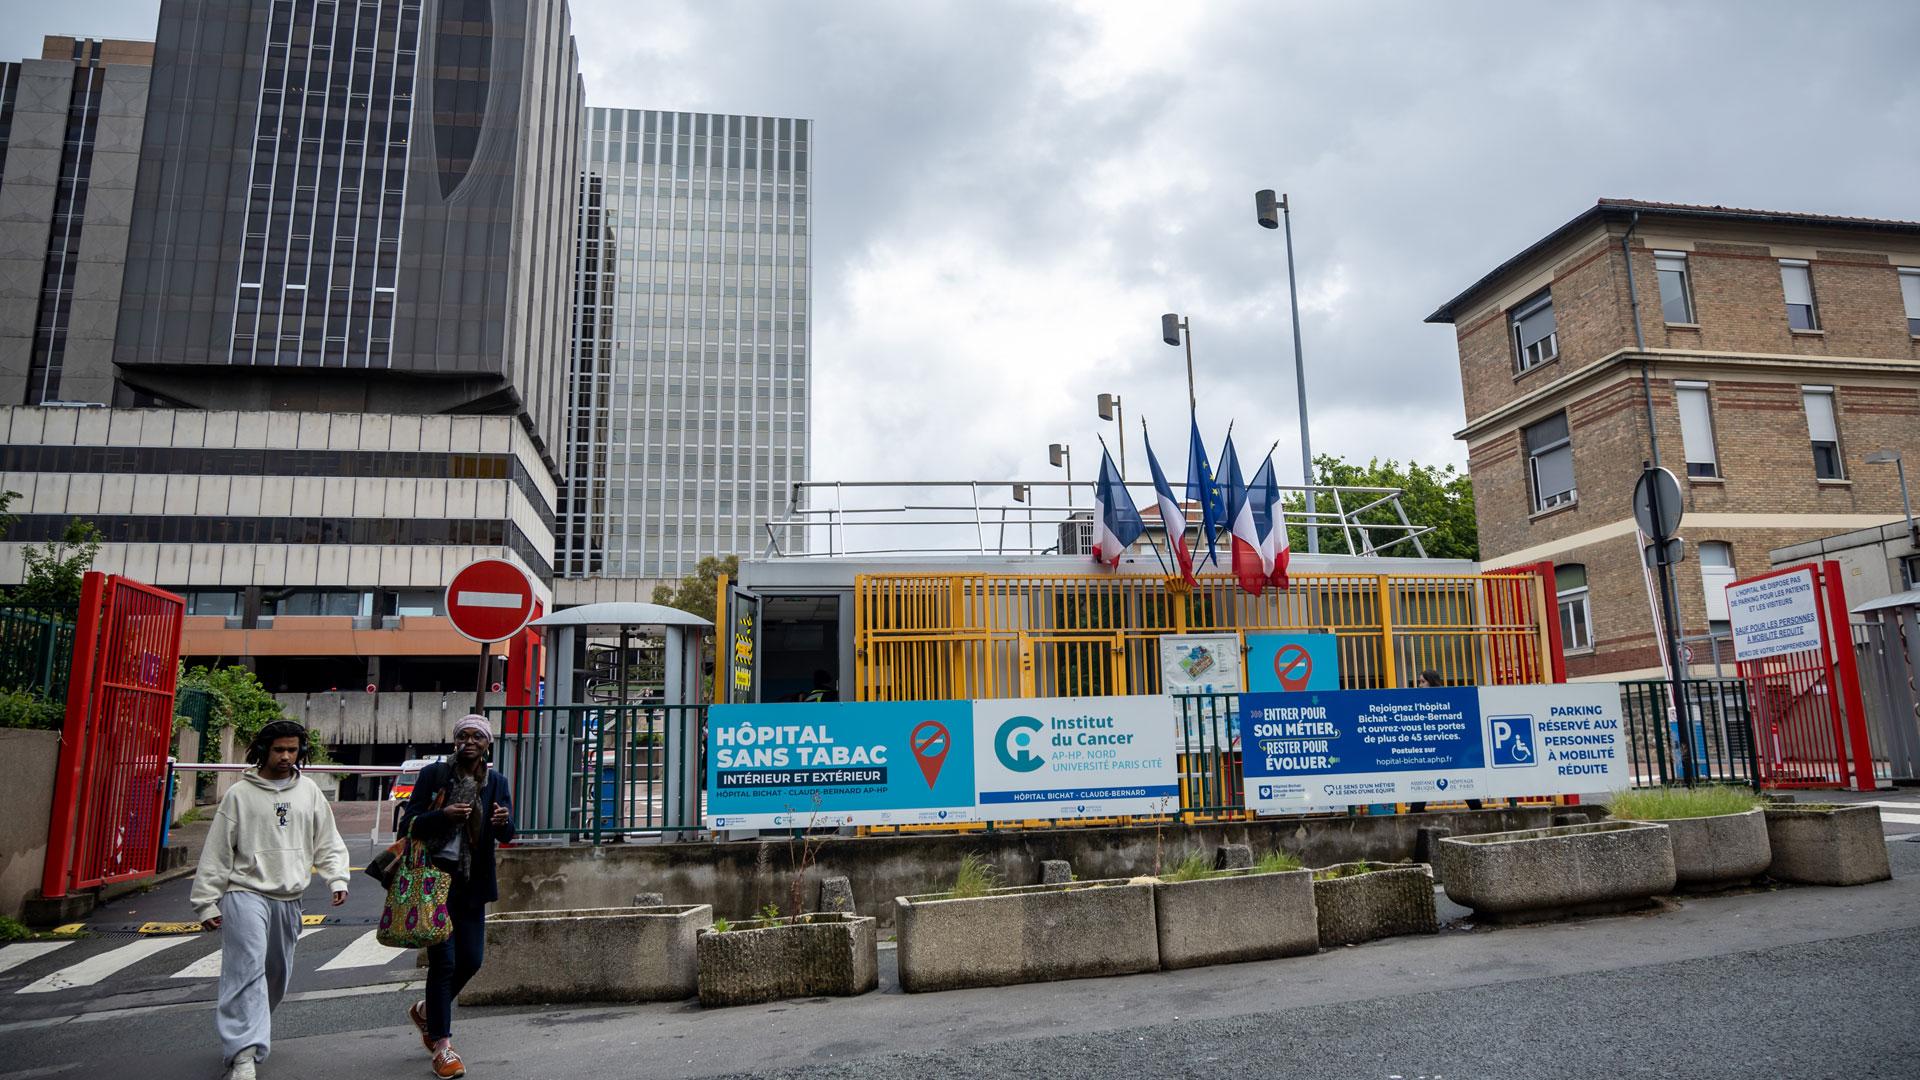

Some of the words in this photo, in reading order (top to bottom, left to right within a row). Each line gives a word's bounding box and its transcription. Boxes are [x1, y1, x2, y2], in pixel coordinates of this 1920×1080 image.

[1768, 579, 1789, 589] DISPOSE
[1739, 596, 1759, 605] PARKING
[1760, 592, 1773, 600] POUR
[1785, 584, 1810, 594] PATIENTS
[1767, 598, 1793, 608] VISITEURS
[1735, 626, 1748, 634] SAUF
[1750, 623, 1765, 632] POUR
[1767, 620, 1778, 629] LES
[1779, 613, 1815, 627] PERSONNES
[1264, 708, 1298, 721] ENTRER
[1301, 707, 1326, 720] POUR
[1369, 704, 1412, 714] Rejoignez
[1414, 702, 1450, 713] l'hôpital
[1551, 705, 1602, 716] PARKING
[1051, 716, 1114, 730] Institut
[1359, 714, 1386, 722] Bichat
[1394, 712, 1462, 722] Claude-Bernard
[1254, 724, 1282, 737] SON
[1286, 720, 1338, 736] MÉTIER,
[1368, 724, 1421, 733] ouvrez-vous
[1423, 722, 1436, 731] les
[1438, 722, 1465, 732] portes
[1539, 719, 1590, 731] RÉSERVÉ
[1594, 720, 1618, 729] AUX
[716, 722, 833, 746] HÔPITAL
[1052, 733, 1072, 746] du
[1077, 732, 1133, 745] Cancer
[1364, 735, 1375, 743] de
[1378, 734, 1396, 744] plus
[1399, 734, 1409, 742] de
[1411, 733, 1422, 741] 45
[1424, 732, 1460, 741] services.
[1494, 721, 1511, 749] P
[1545, 734, 1614, 746] PERSONNES
[1267, 741, 1300, 754] RESTER
[1302, 740, 1328, 753] POUR
[717, 747, 789, 768] SANS
[797, 745, 887, 765] TABAC
[1088, 750, 1116, 759] NORD
[1548, 750, 1556, 760] À
[1560, 747, 1614, 760] MOBILITÉ
[1053, 761, 1109, 772] UNIVERSITÉ
[1112, 760, 1139, 769] PARIS
[1142, 758, 1162, 768] CITÉ
[1266, 754, 1331, 771] ÉVOLUER.
[1377, 755, 1452, 766] hopital-bichat.aphp.fr
[1558, 763, 1608, 775] RÉDUITE
[723, 771, 790, 785] INTÉRIEUR
[794, 773, 809, 783] ET
[813, 769, 880, 782] EXTÉRIEUR
[716, 789, 750, 798] HÔPITAL
[789, 788, 861, 796] CLAUDE-BERNARD
[1014, 792, 1045, 800] HÔPITAL
[1080, 789, 1146, 798] CLAUDE-BERNARD
